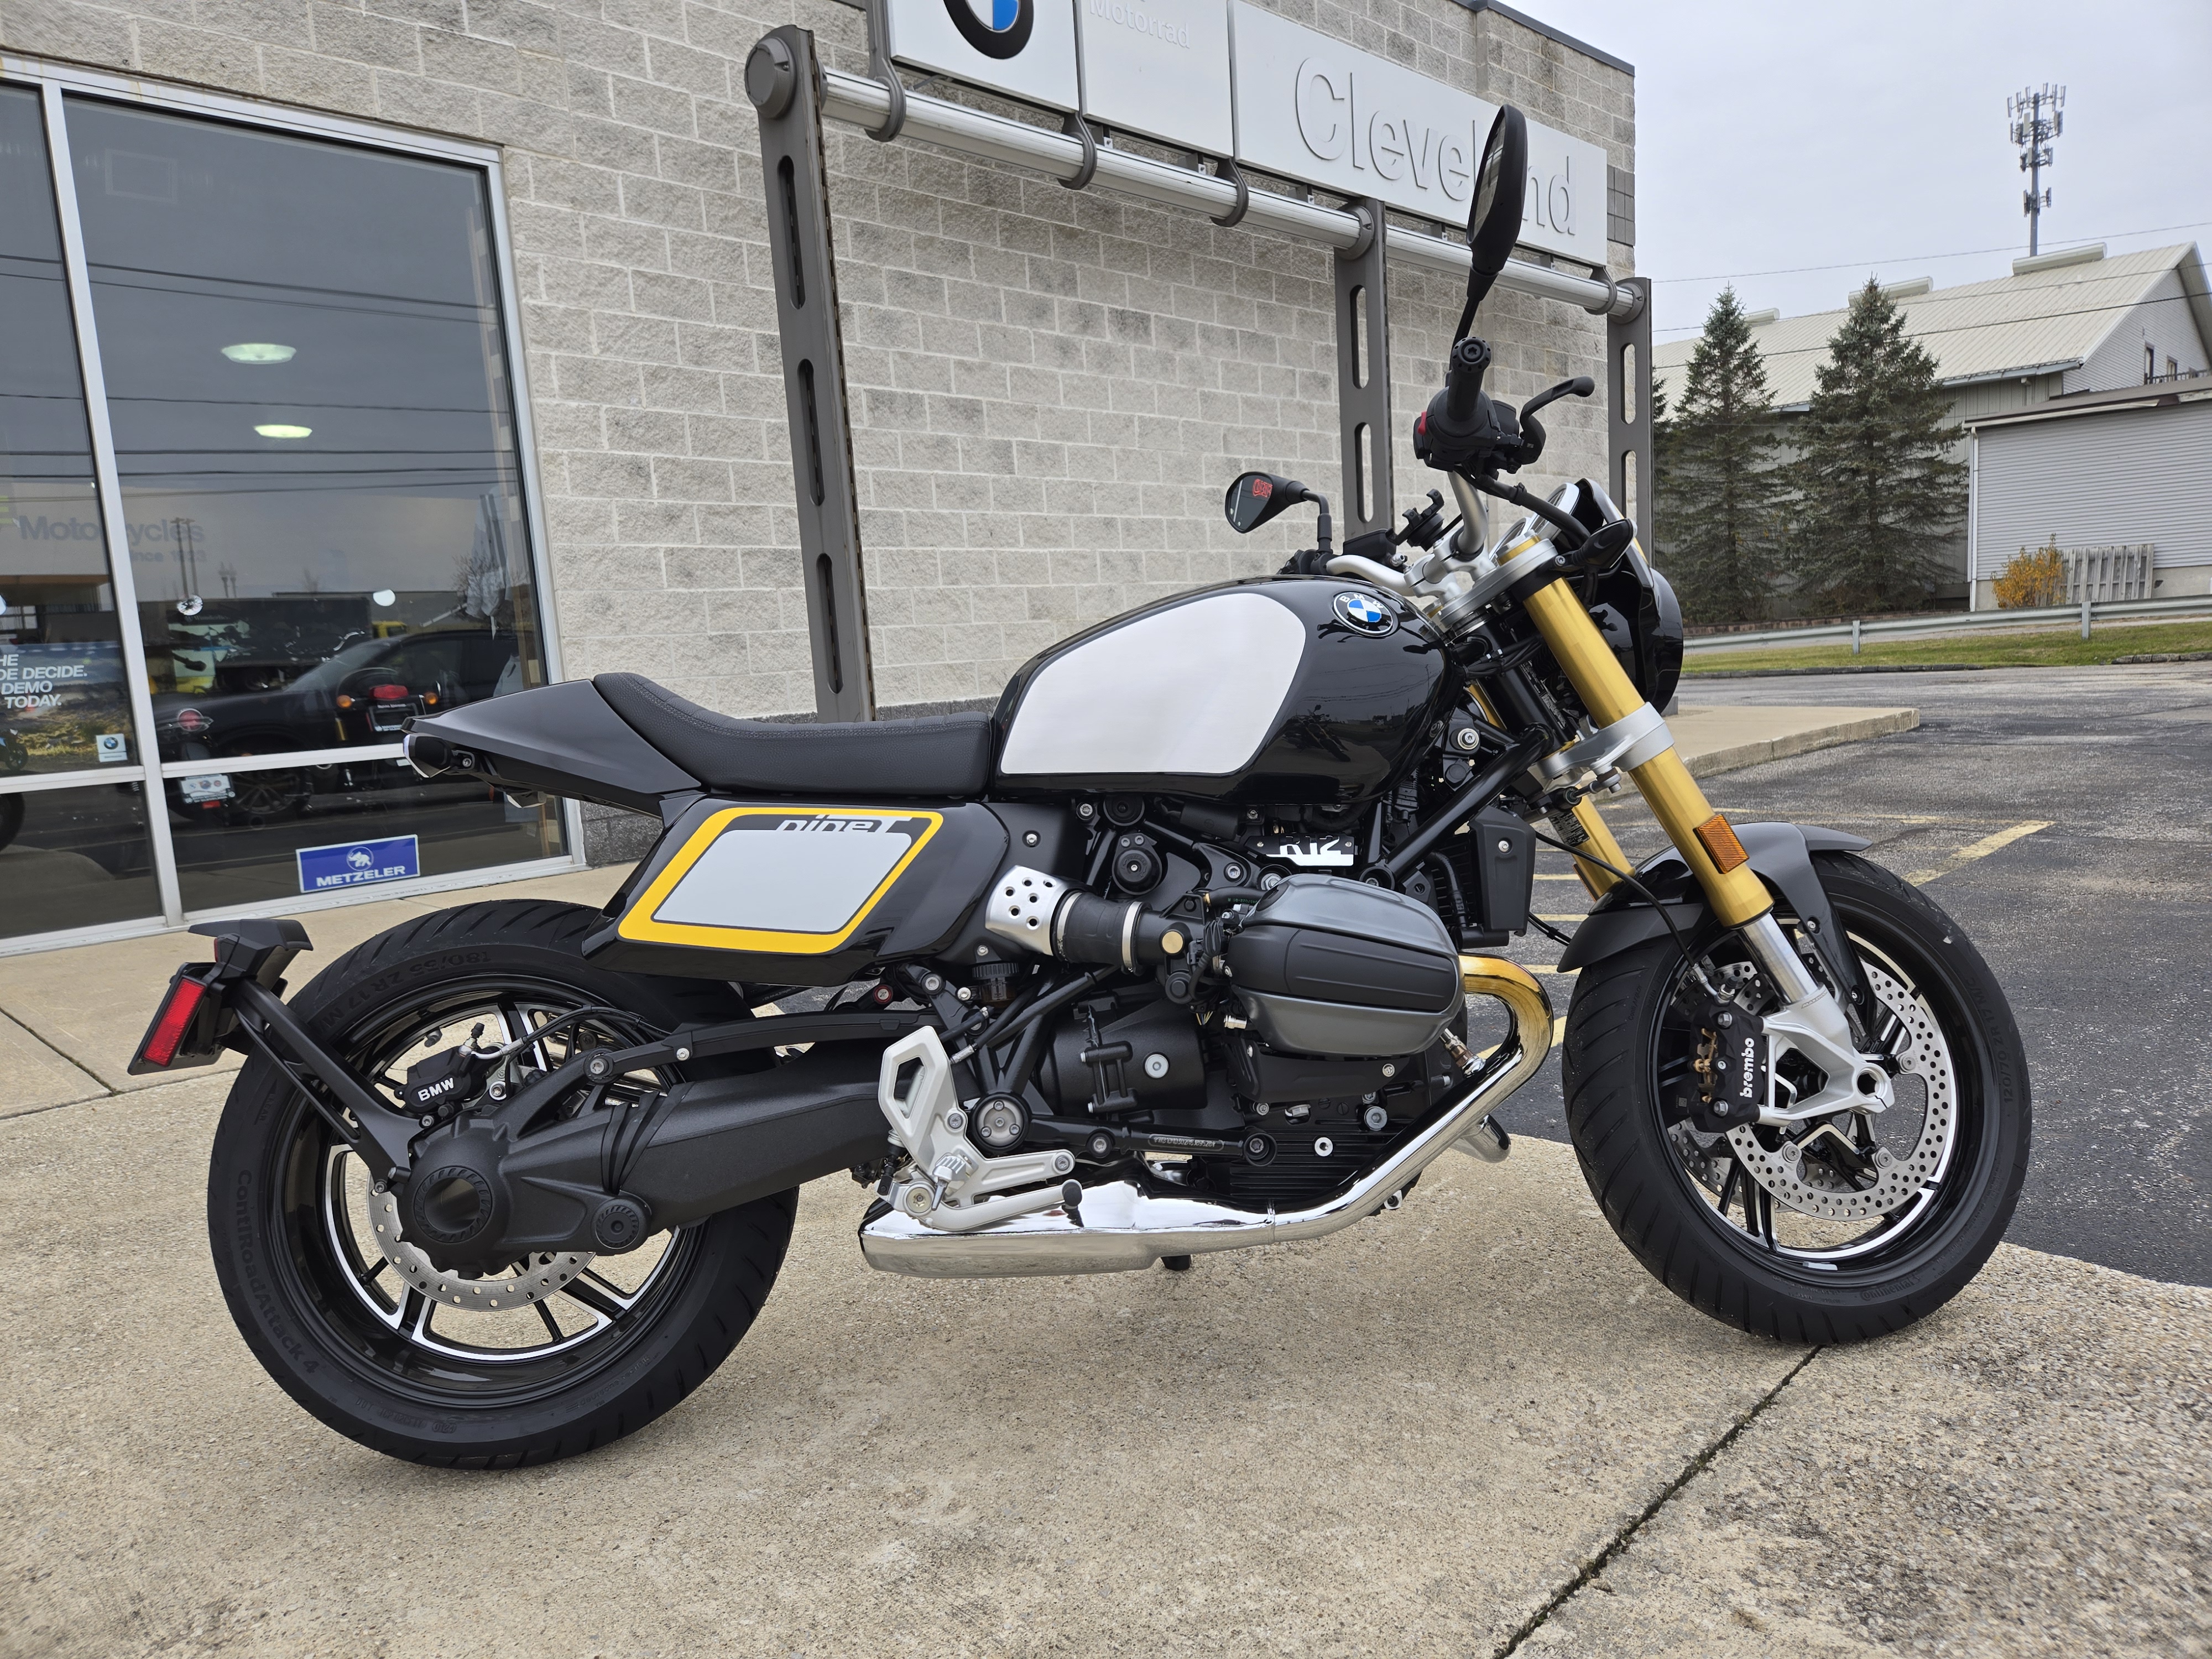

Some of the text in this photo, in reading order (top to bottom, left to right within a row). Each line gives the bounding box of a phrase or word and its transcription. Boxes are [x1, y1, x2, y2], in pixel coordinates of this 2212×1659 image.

[1089, 0, 1190, 49] Motorrad
[1295, 56, 1576, 236] Clevelnd
[1339, 593, 1384, 609] BMW
[22, 665, 88, 680] DECIDE.
[1, 680, 53, 695] DEMO
[4, 693, 62, 709] TODAY.
[316, 865, 406, 888] METZELER
[409, 950, 492, 977] 180/55
[371, 972, 405, 993] ZR
[347, 992, 368, 1009] 17
[1966, 977, 2013, 1104] 120/70 ZR 17 M/C
[1739, 1037, 1755, 1098] brembo
[418, 1077, 455, 1102] BMW
[303, 1360, 320, 1374] 4
